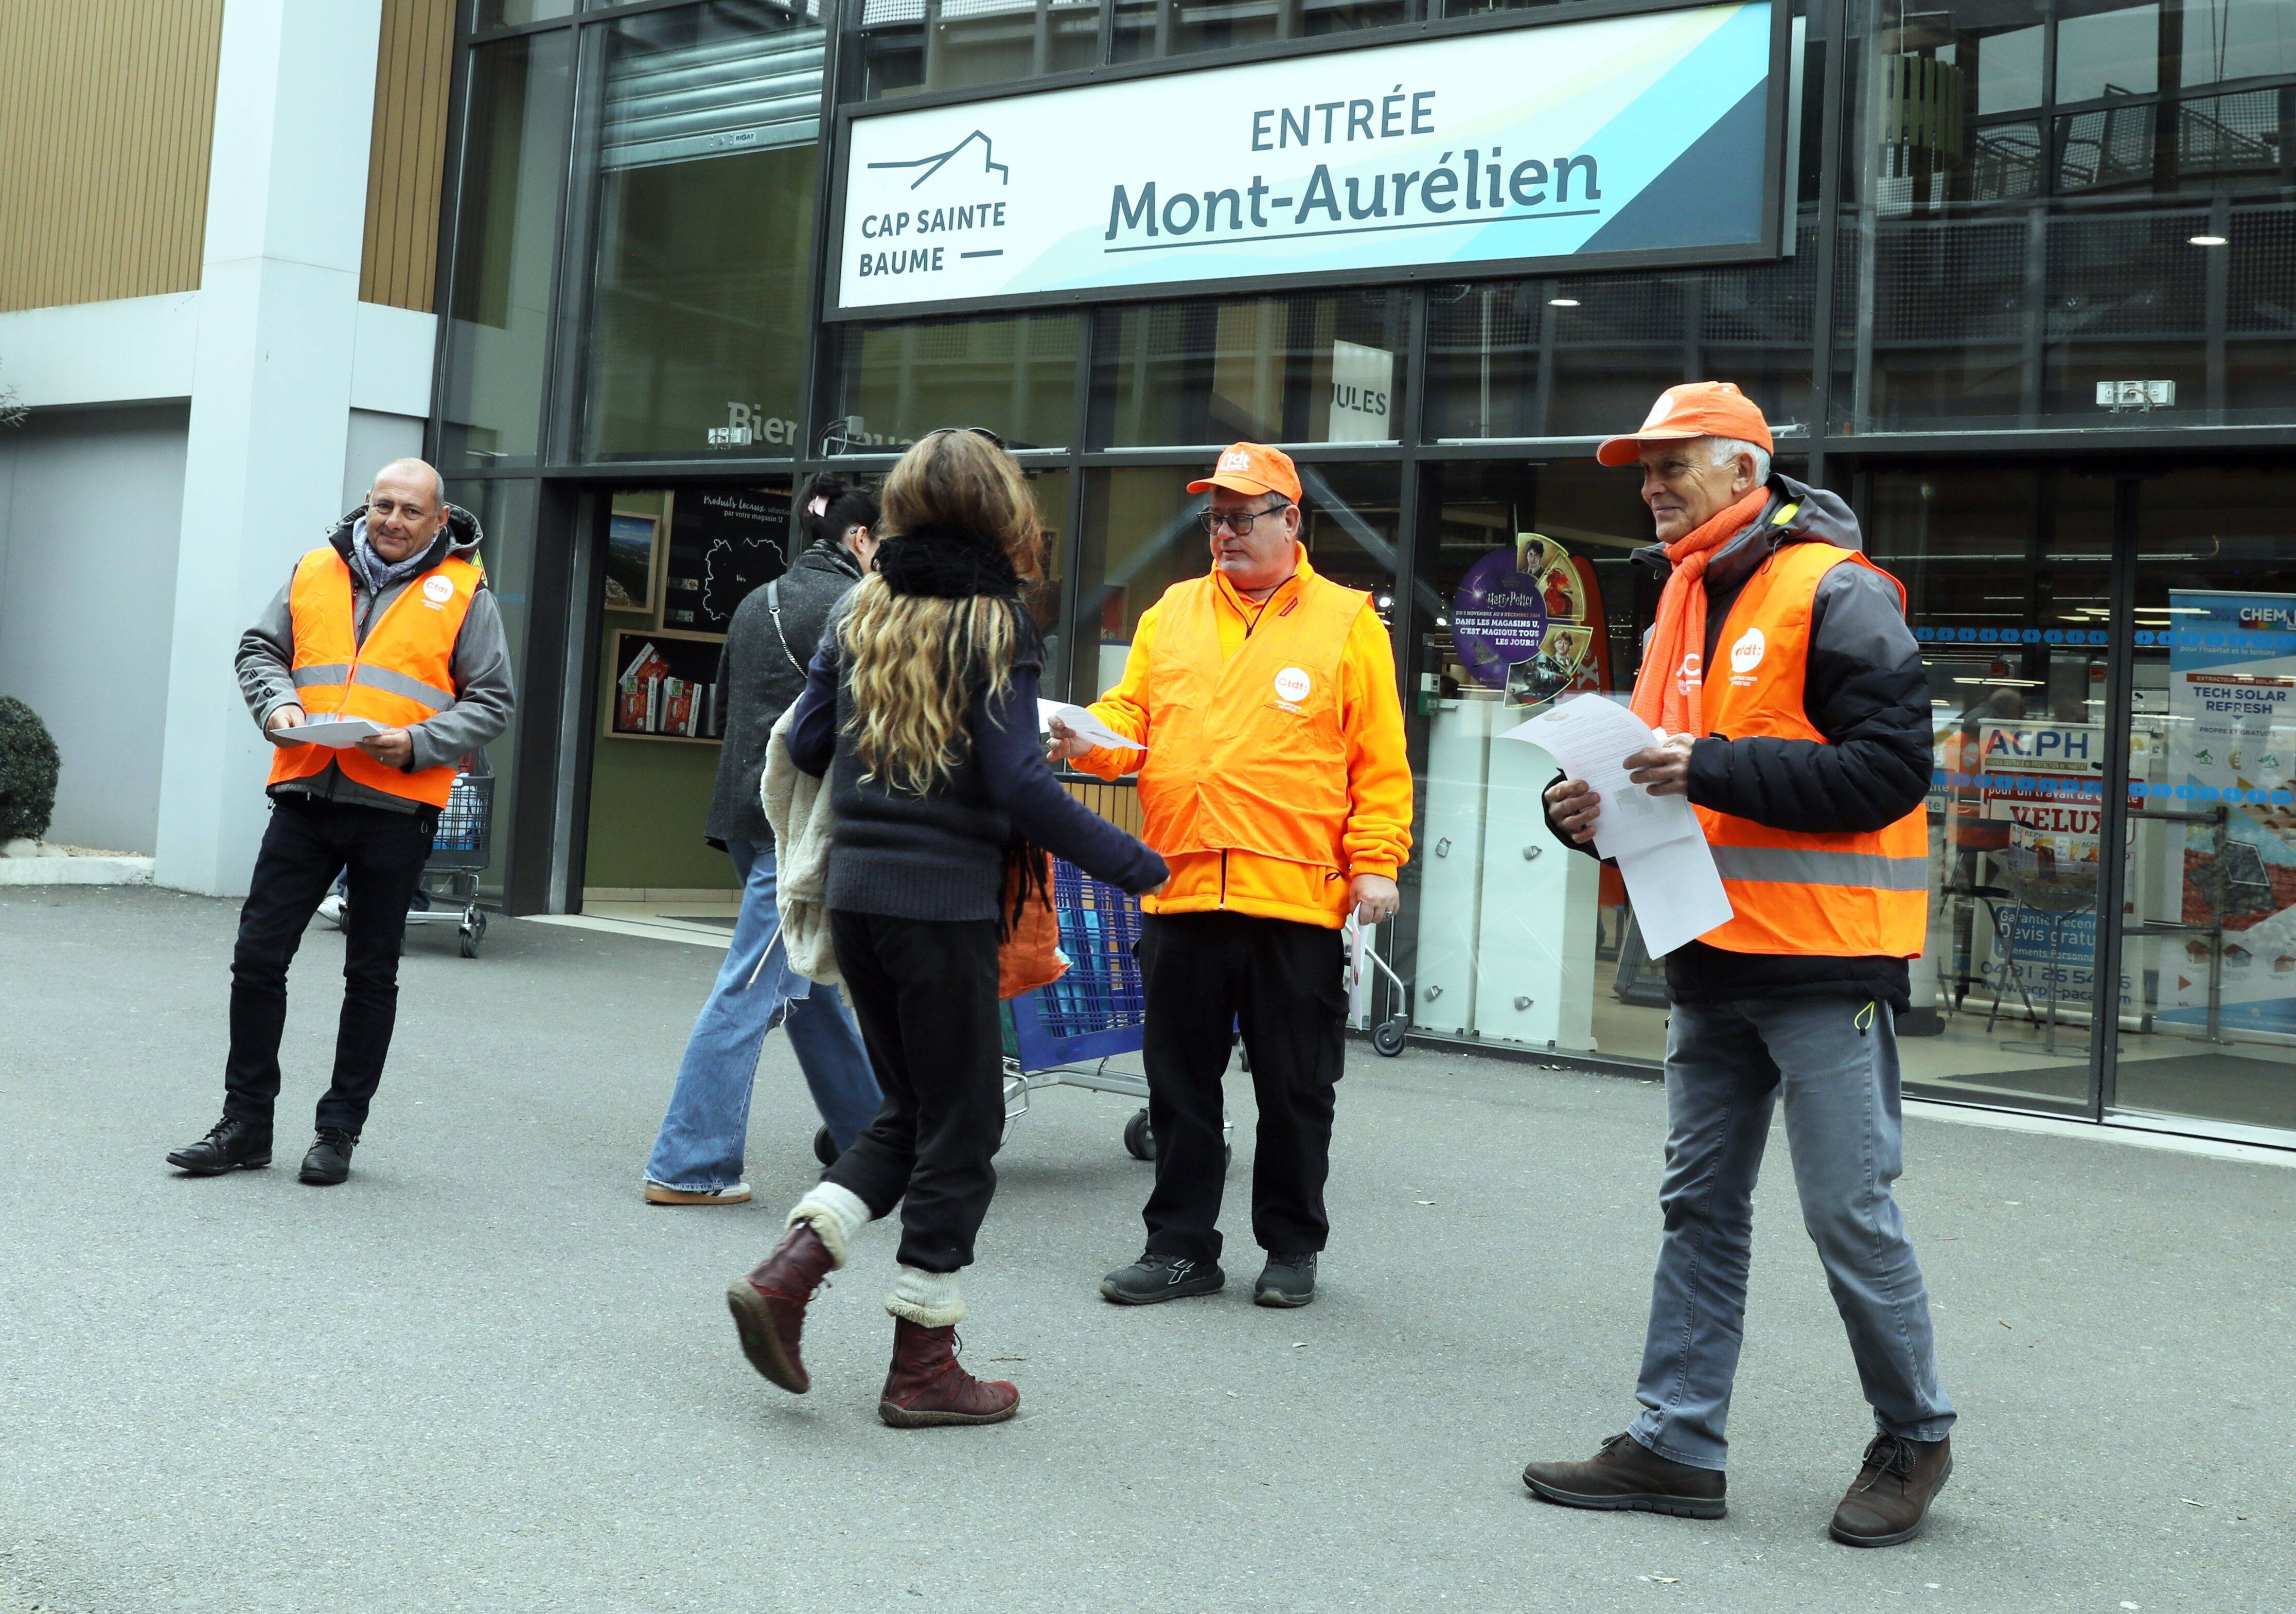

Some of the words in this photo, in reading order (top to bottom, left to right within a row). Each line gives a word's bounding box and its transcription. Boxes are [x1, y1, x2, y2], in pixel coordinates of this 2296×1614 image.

[1251, 83, 1436, 152] ENTRÉE
[1105, 146, 1601, 240] Mont-Aurélien
[861, 212, 910, 239] CAP
[916, 202, 1006, 234] SAINTE
[859, 247, 944, 277] BAUME
[1486, 592, 1509, 608] Harry
[1510, 591, 1533, 607] Potter
[2193, 686, 2231, 699] TECH
[2235, 689, 2286, 702] SOLAR
[2206, 700, 2273, 714] REFRESH
[2199, 726, 2228, 735] PROPRE
[1985, 729, 2088, 759] ACPH
[2000, 911, 2050, 925] Gaantie
[2000, 923, 2044, 942] Devis
